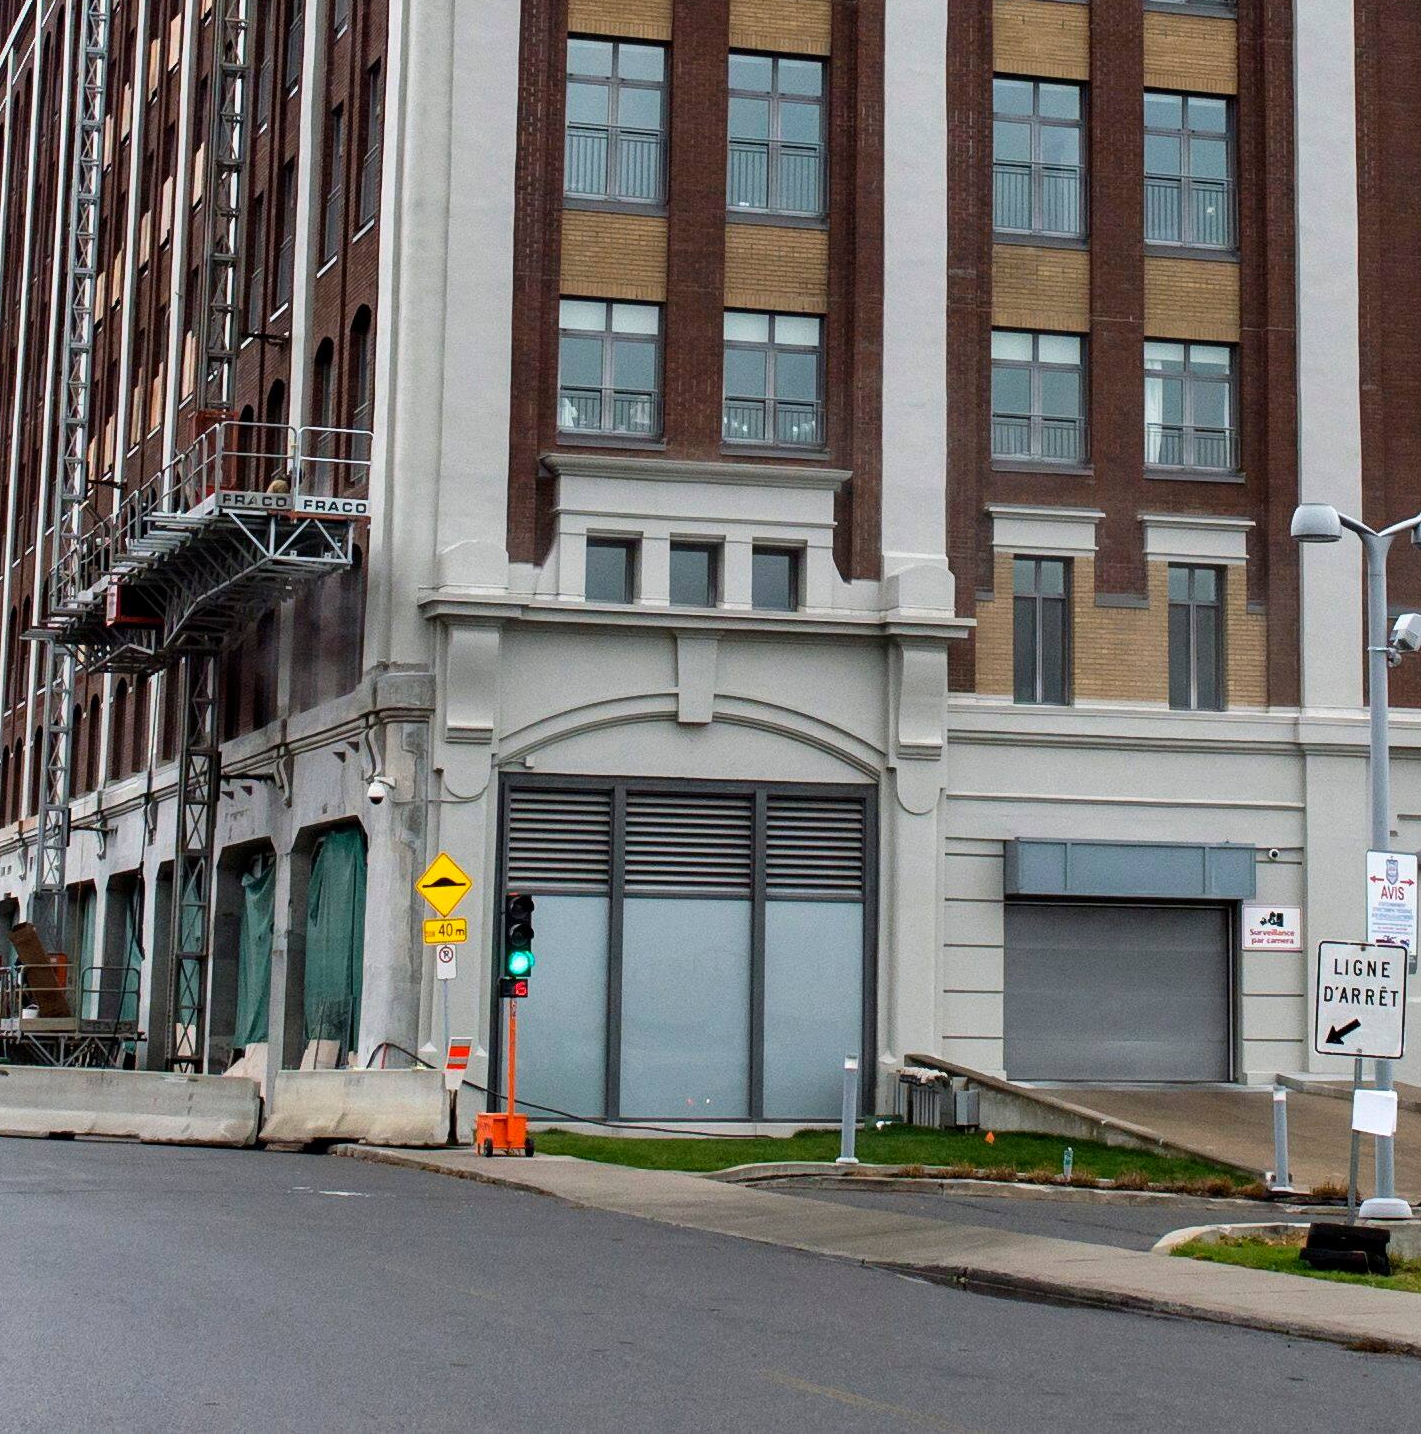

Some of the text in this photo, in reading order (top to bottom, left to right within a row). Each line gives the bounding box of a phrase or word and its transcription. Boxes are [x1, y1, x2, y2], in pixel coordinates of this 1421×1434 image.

[222, 493, 288, 508] FRACO
[303, 498, 368, 514] FRACO
[1380, 883, 1406, 901] AVIS
[438, 922, 453, 937] 40
[1333, 958, 1391, 979] LIGNE
[1323, 985, 1399, 1008] D'ARRÊT
